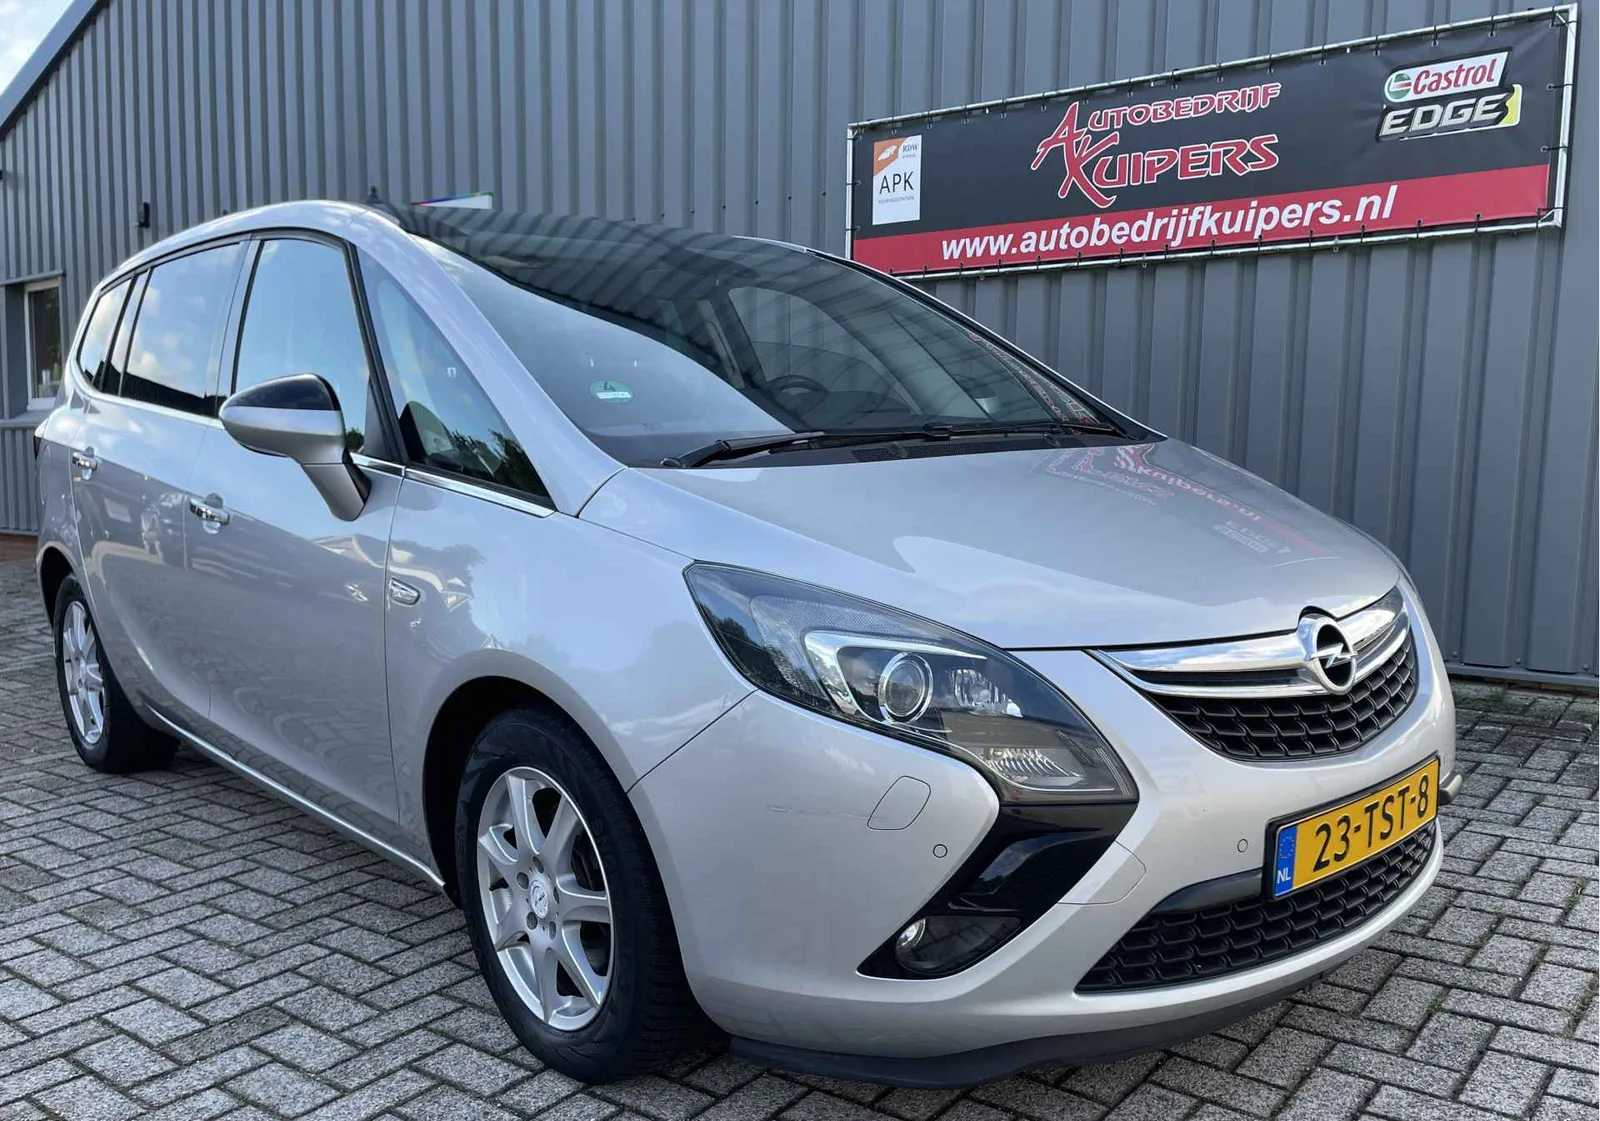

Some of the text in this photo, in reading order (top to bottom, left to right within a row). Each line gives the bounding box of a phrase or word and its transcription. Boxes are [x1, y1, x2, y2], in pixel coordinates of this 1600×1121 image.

[1412, 58, 1497, 95] Castrol
[1030, 82, 1282, 171] AUTOBEDRIJF
[1378, 92, 1511, 138] EDGE
[879, 171, 914, 194] APK
[1057, 133, 1280, 209] KUIPERS
[941, 184, 1399, 261] www.autobedrijfkuipers.nl
[1312, 774, 1430, 873] 23-TST-8
[1276, 867, 1292, 884] NL
